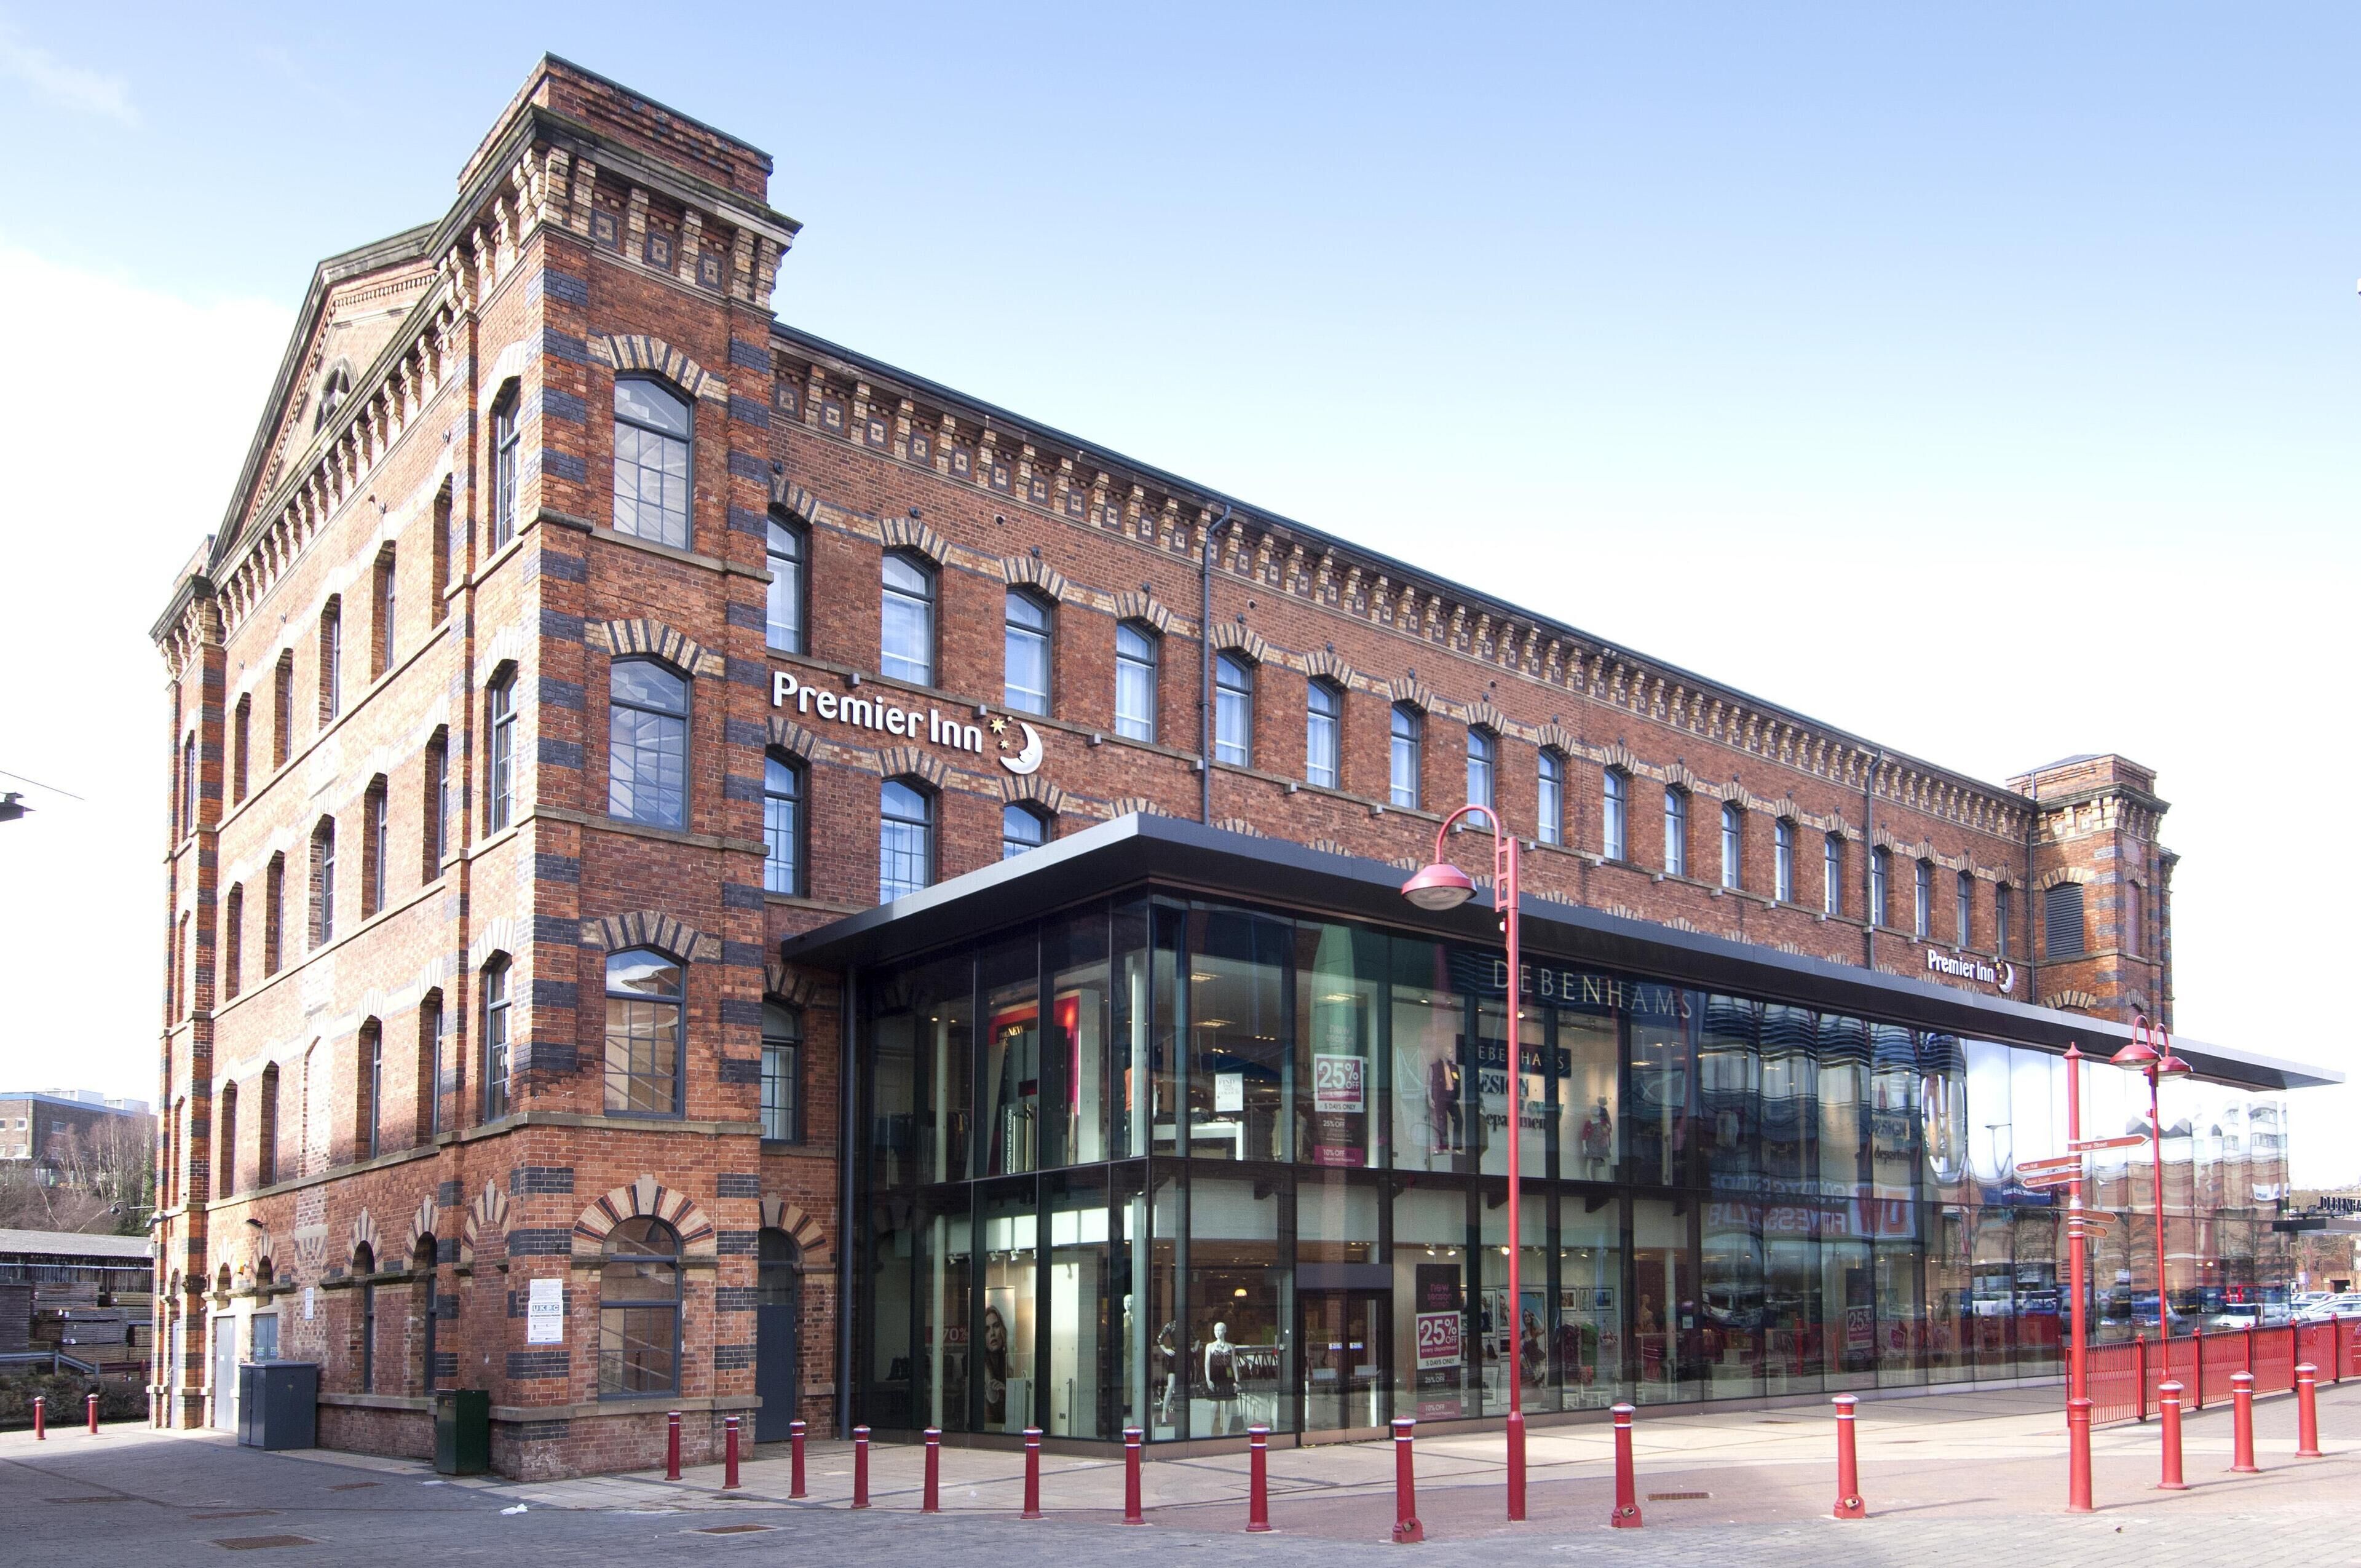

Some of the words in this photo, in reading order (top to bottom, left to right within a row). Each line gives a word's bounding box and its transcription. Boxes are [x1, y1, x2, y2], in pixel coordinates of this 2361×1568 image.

[773, 670, 924, 738] Premier
[930, 709, 983, 753] Inn
[1928, 949, 1975, 978] Premier
[1977, 961, 1994, 983] Inn
[1493, 959, 1693, 1019] DEBENHAMS
[1479, 1045, 1564, 1069] EBEHAS
[1318, 1061, 1359, 1089] 25%
[1345, 1081, 1359, 1090] OFF
[1430, 1284, 1449, 1293] new
[1420, 1319, 1457, 1347] 25%
[1849, 1311, 1871, 1331] 25%
[1445, 1335, 1458, 1345] OFF
